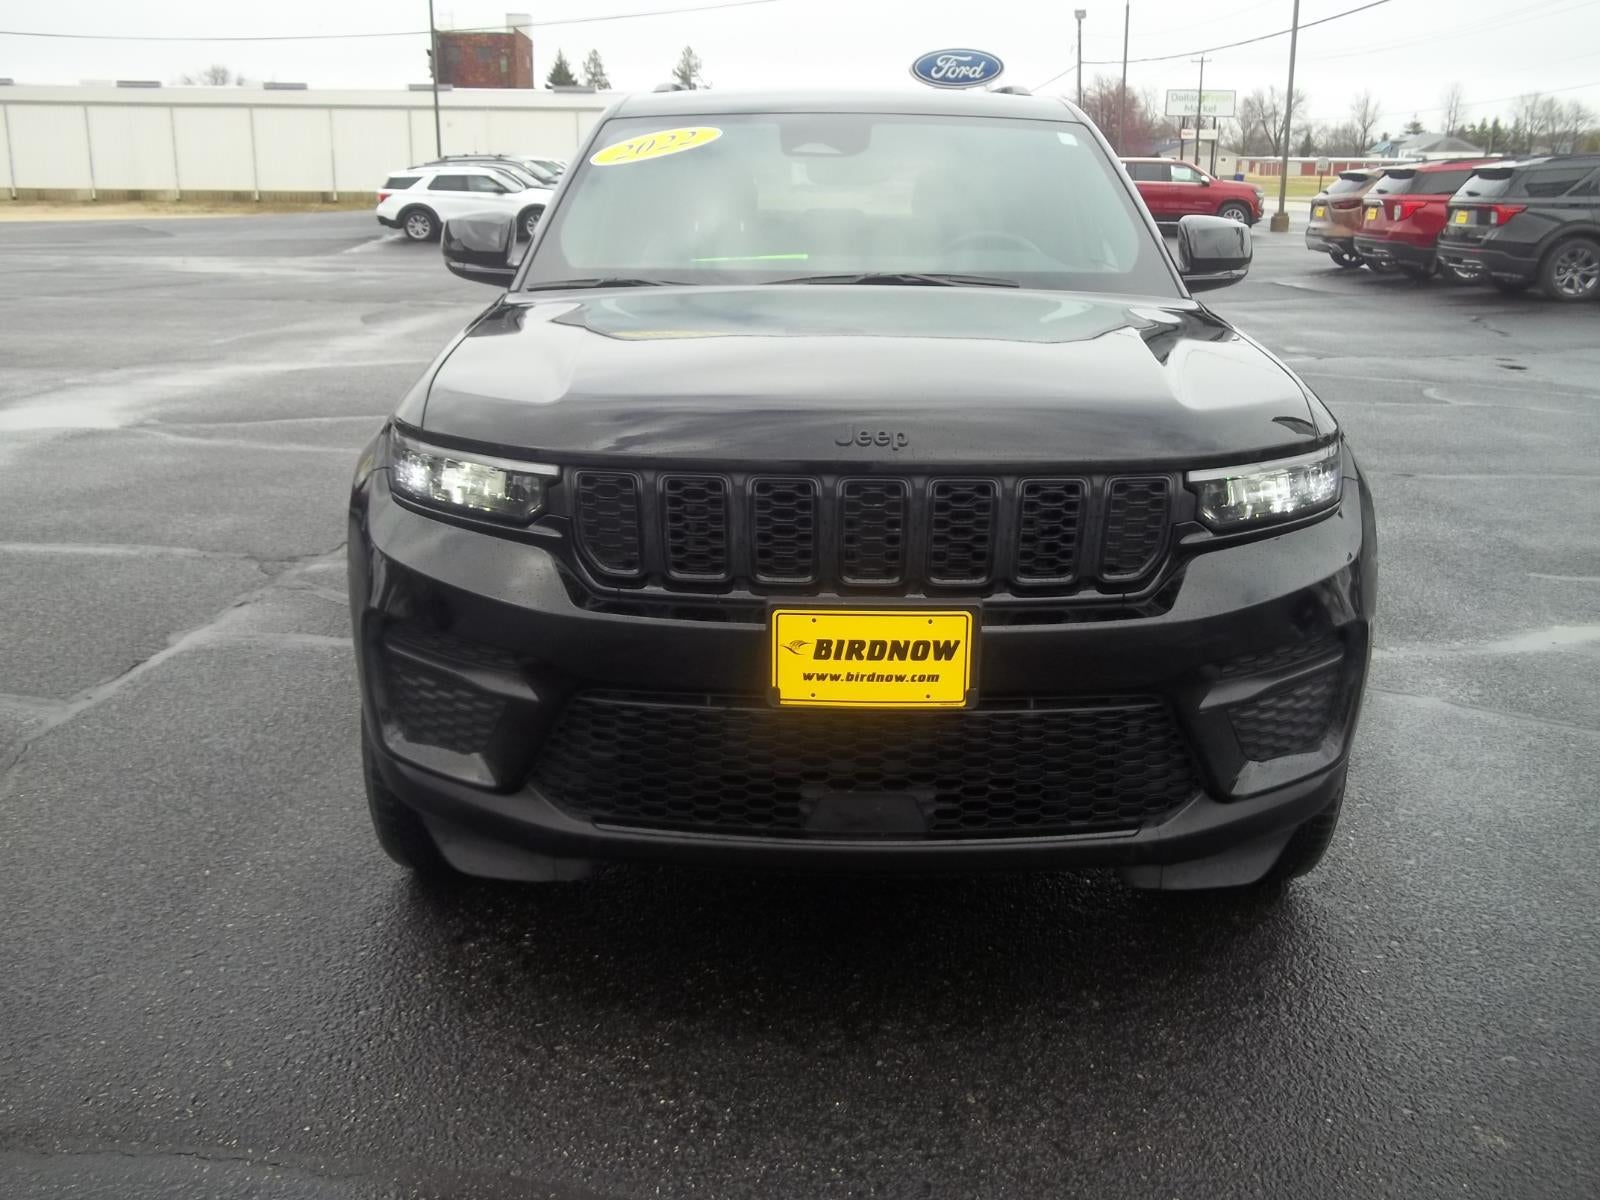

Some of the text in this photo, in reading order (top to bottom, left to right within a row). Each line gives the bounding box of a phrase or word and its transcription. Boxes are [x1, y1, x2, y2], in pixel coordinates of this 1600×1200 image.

[931, 55, 986, 79] Ford
[613, 130, 698, 161] 2022
[834, 423, 909, 451] Jeep
[813, 638, 961, 662] BIRDNOW
[802, 671, 940, 683] www.birdnow.com
